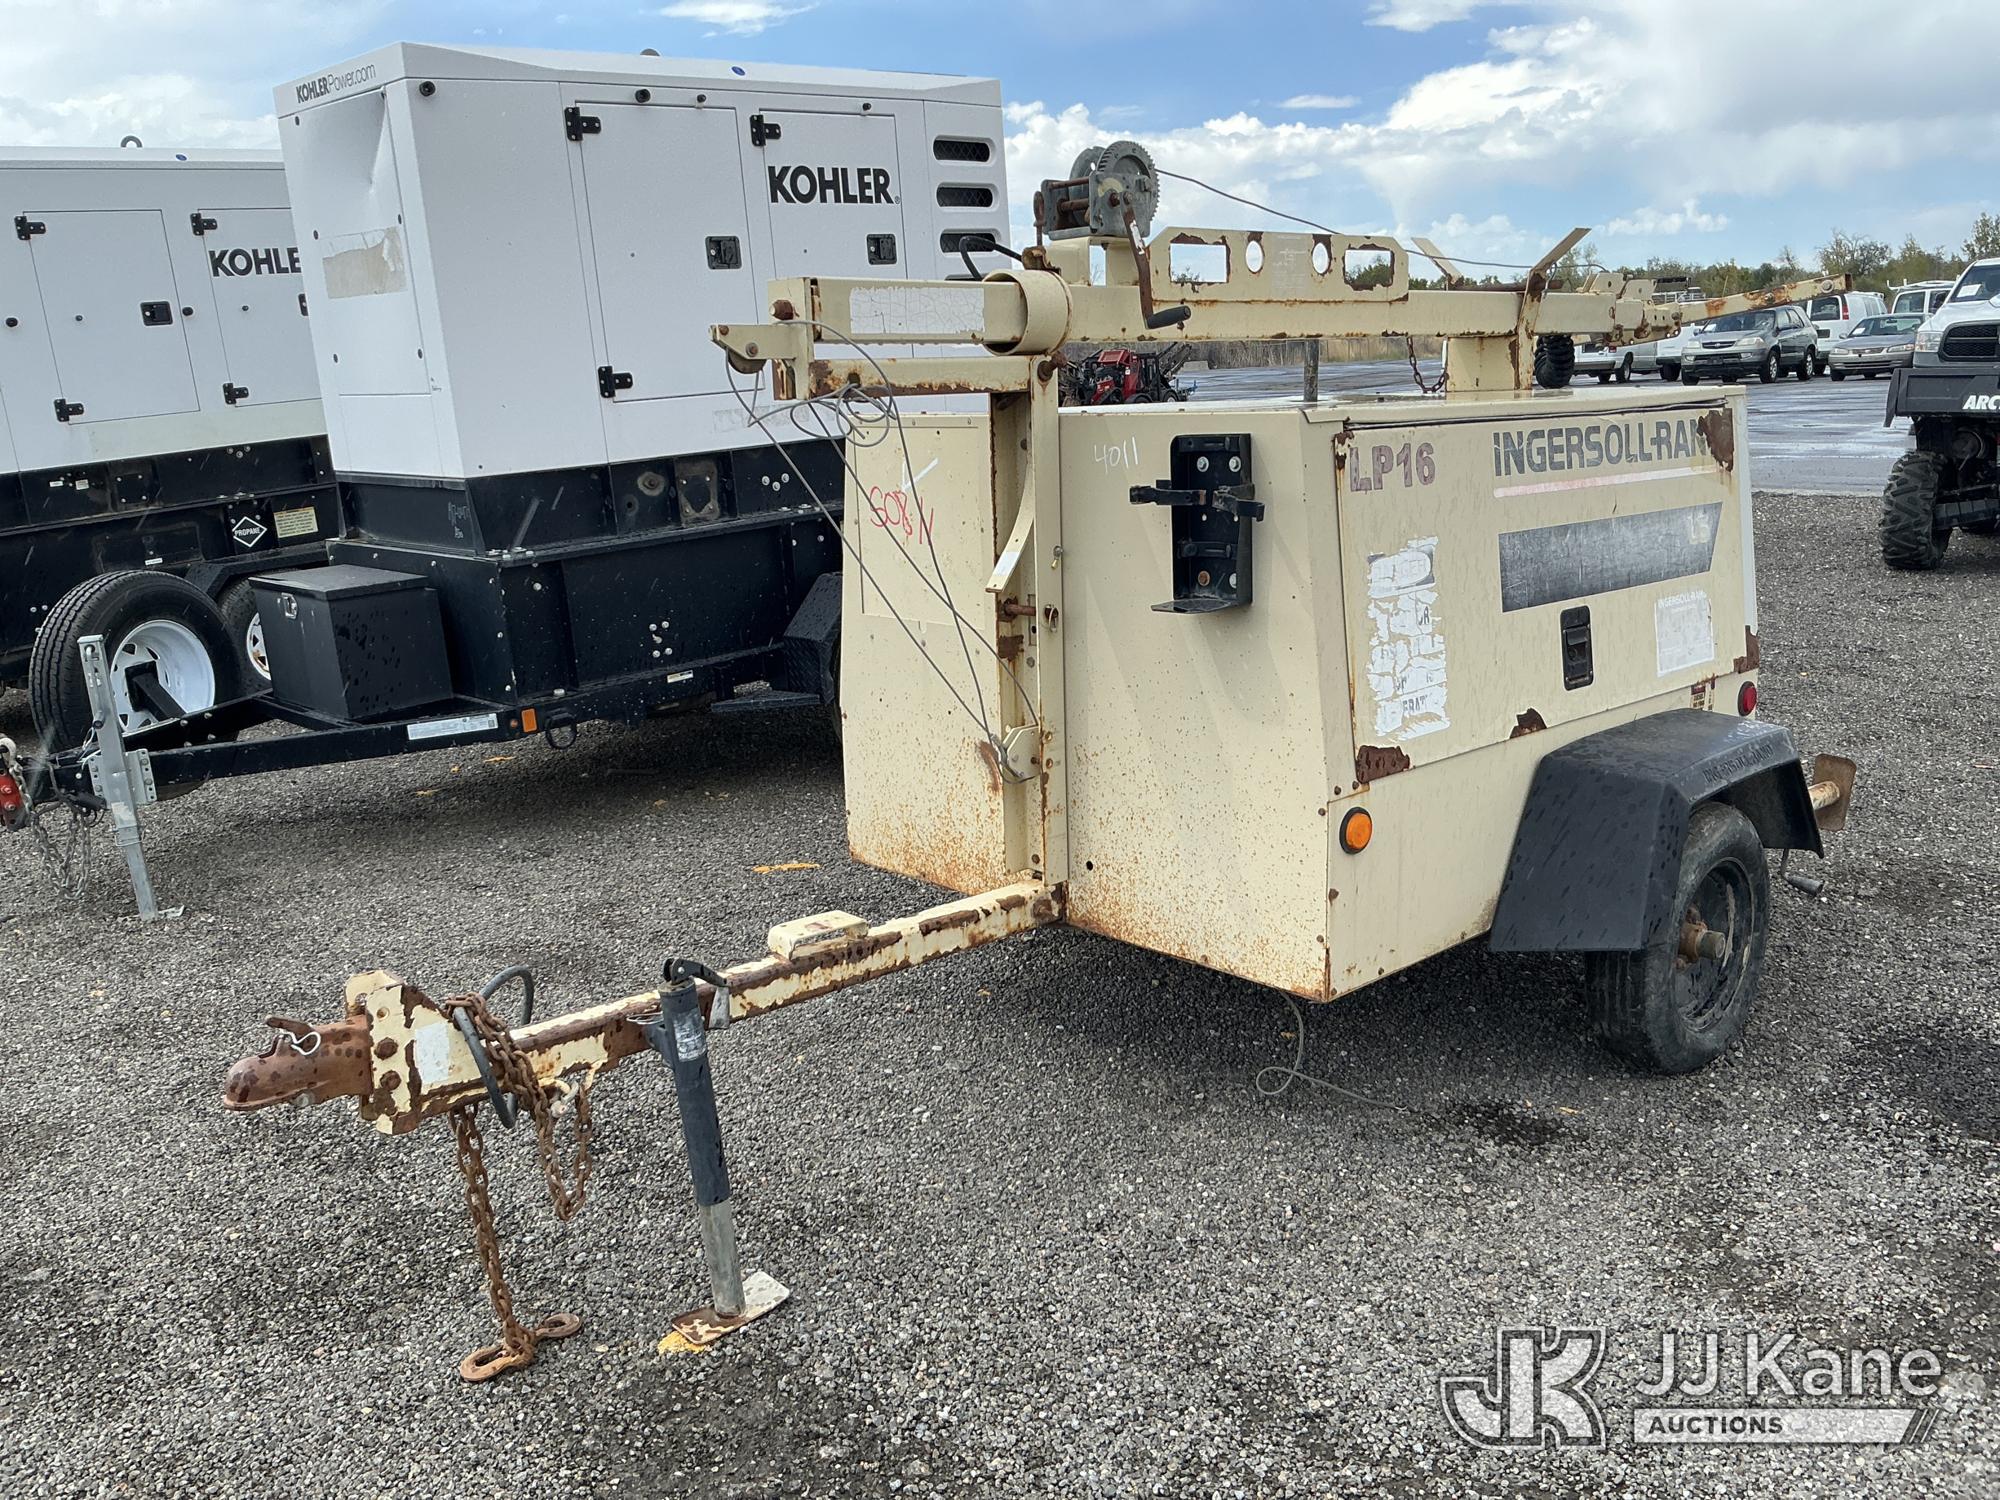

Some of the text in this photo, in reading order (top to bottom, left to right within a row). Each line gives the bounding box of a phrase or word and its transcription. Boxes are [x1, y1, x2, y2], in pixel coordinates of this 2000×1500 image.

[296, 64, 377, 103] KOHLERPower.com
[768, 165, 894, 204] KOHLER
[208, 247, 302, 277] KOHLE
[1962, 395, 2000, 410] ARC
[1094, 436, 1138, 475] 4011
[1350, 442, 1435, 492] LP16
[1493, 418, 1707, 477] INGERSOLL-RAN
